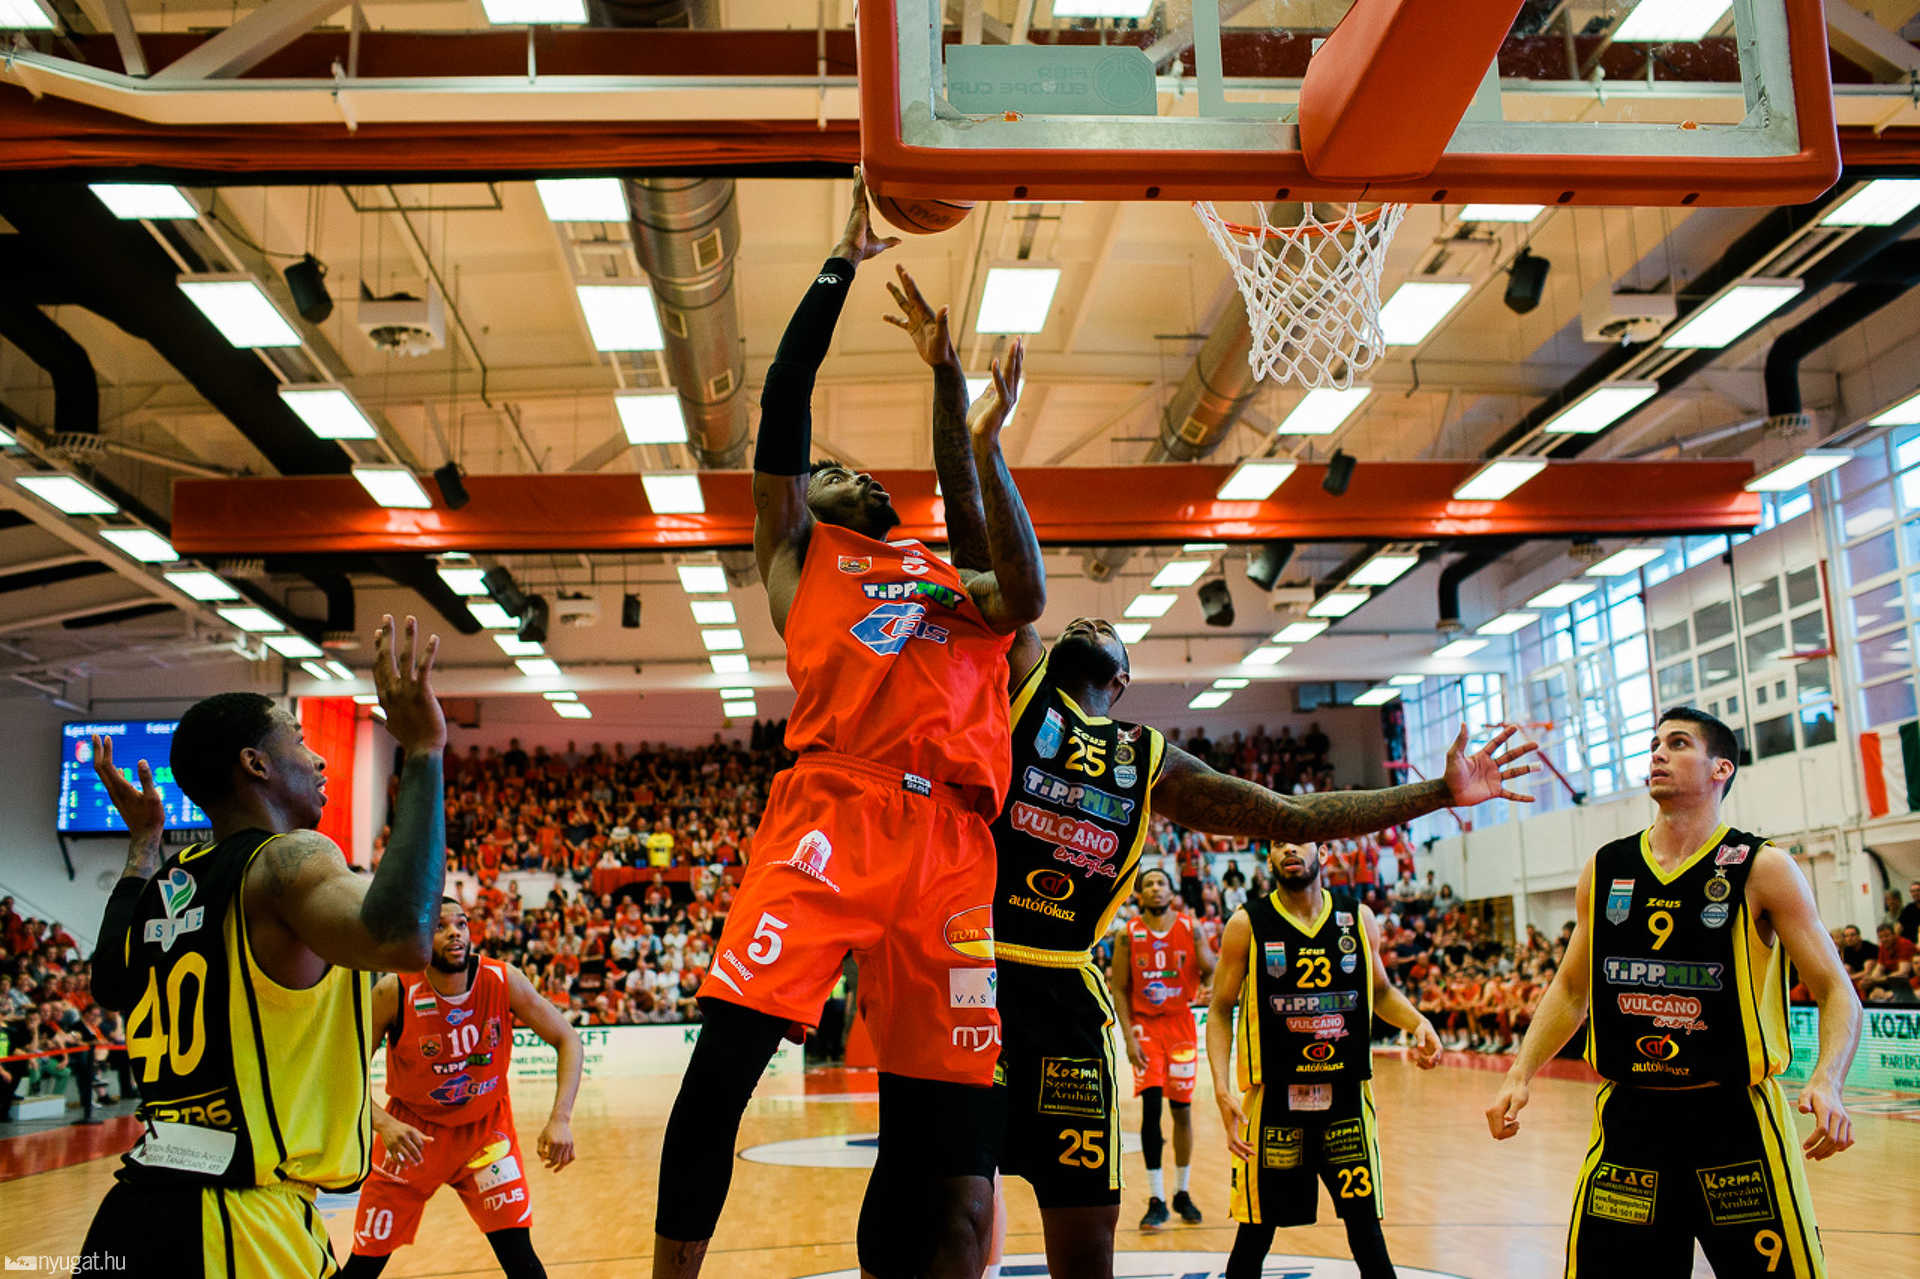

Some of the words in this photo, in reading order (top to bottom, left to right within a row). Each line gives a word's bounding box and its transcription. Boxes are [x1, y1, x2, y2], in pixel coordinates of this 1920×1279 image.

[1065, 736, 1107, 777] 25
[1018, 806, 1113, 853] VULCANO
[1008, 894, 1077, 922] autófókusz
[1645, 897, 1682, 909] Zeus
[747, 912, 789, 965] 5
[1648, 910, 1674, 951] 9
[1154, 950, 1167, 970] 0
[1295, 956, 1333, 989] 23
[125, 951, 208, 1083] 40
[1289, 1017, 1342, 1029] VULCANO
[1621, 997, 1698, 1015] VULCANO
[447, 1023, 480, 1058] 10
[1058, 1128, 1105, 1169] 25
[1337, 1166, 1373, 1199] 23
[1597, 1166, 1655, 1189] FLAG
[359, 1206, 394, 1240] 10
[1753, 1229, 1783, 1273] 9
